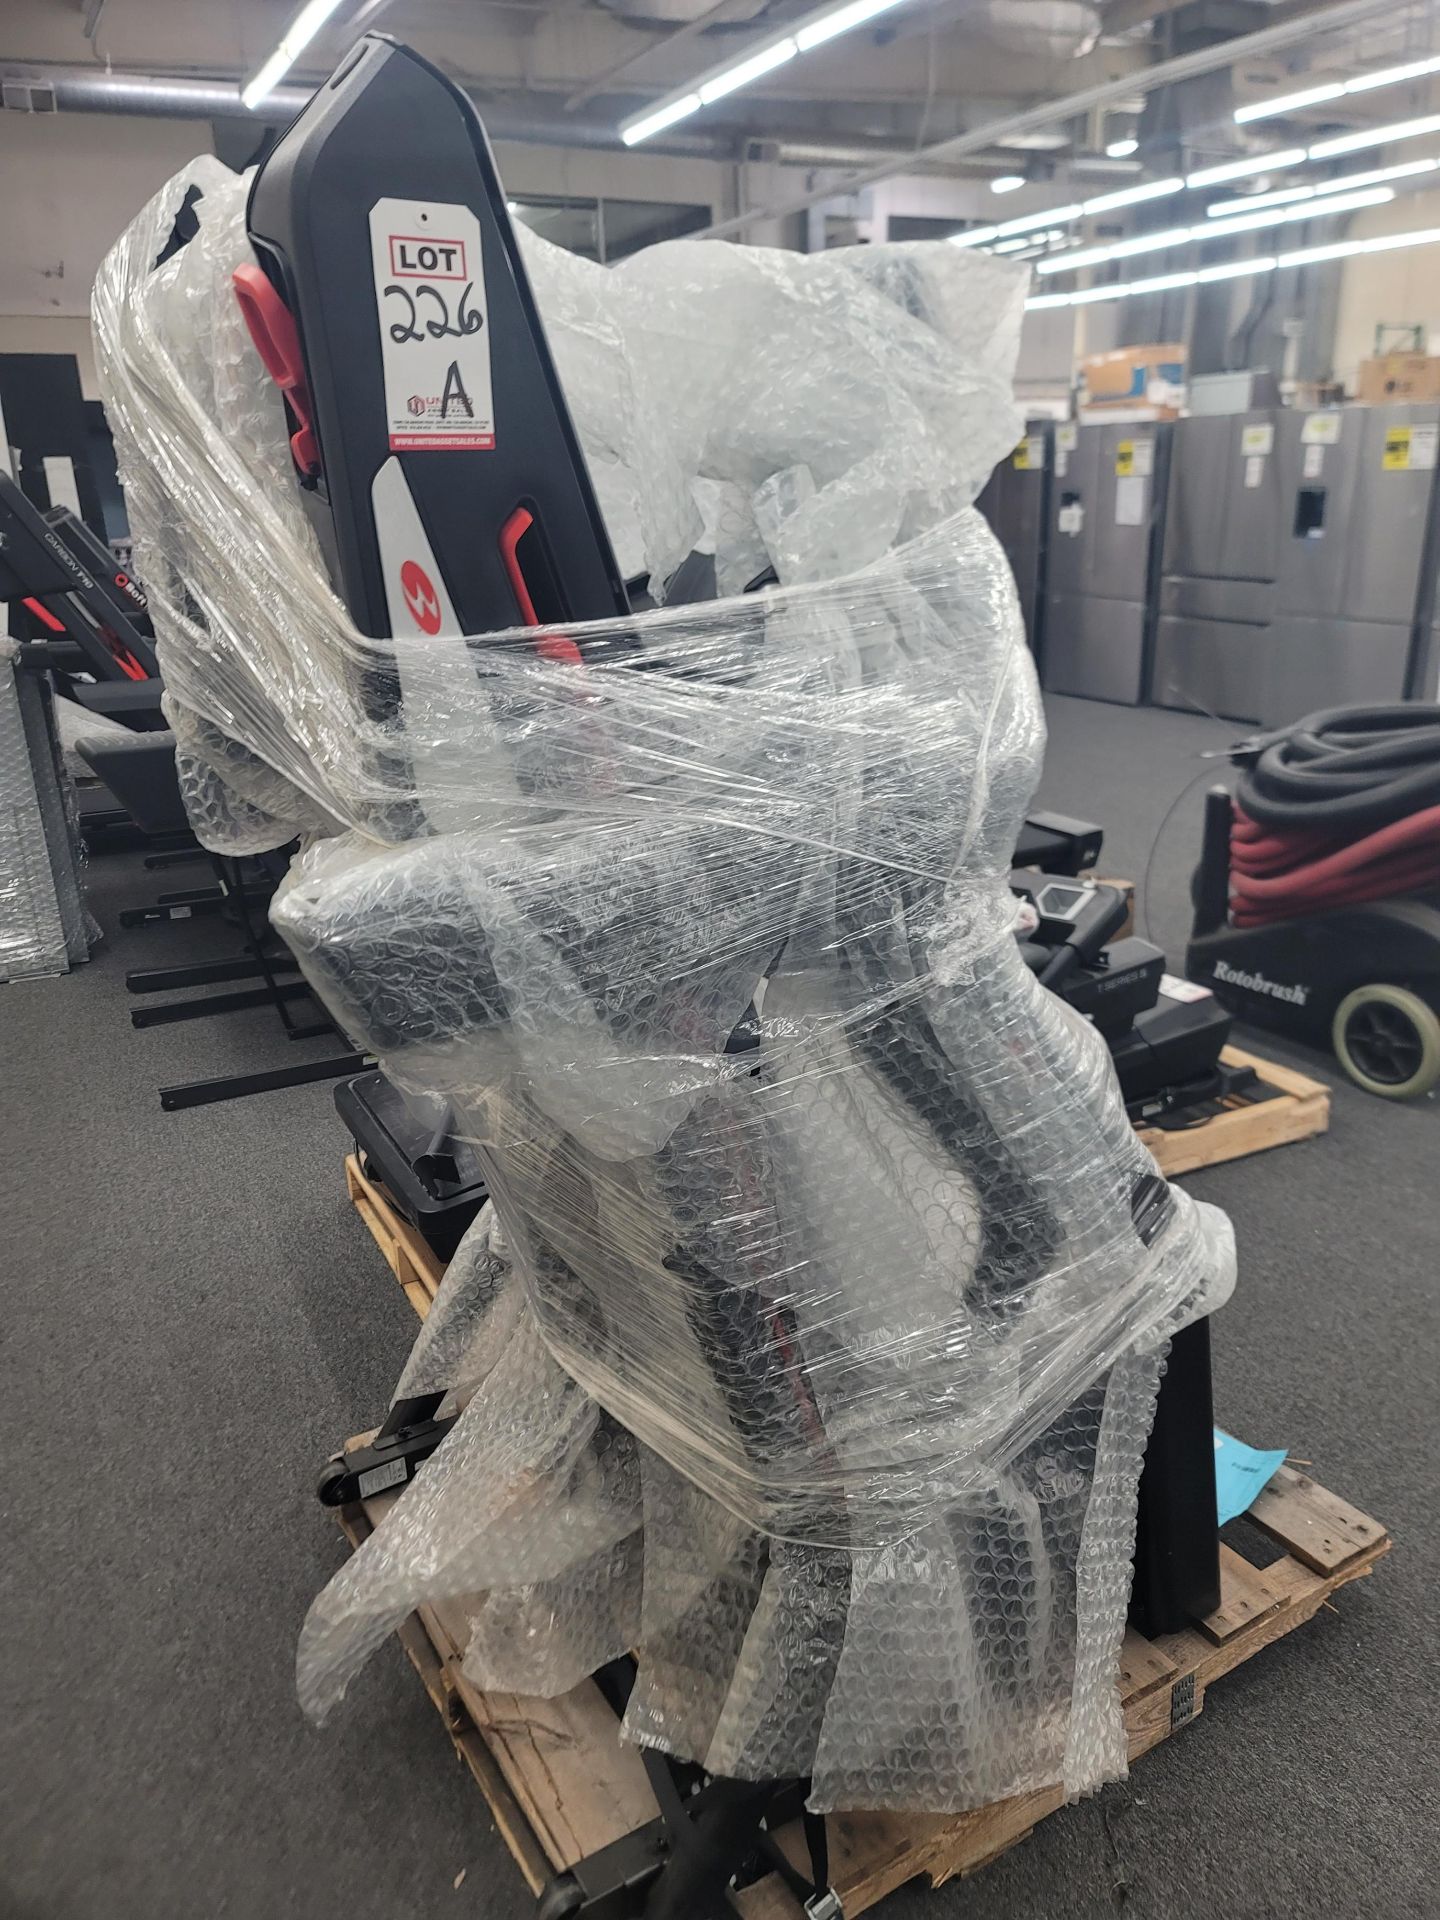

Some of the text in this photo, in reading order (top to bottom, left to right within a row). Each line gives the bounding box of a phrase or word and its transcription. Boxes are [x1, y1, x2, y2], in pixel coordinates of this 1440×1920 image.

[399, 244, 457, 272] LOT
[384, 282, 483, 343] 226
[441, 360, 474, 419] A
[1213, 960, 1306, 1006] Rotobrush
